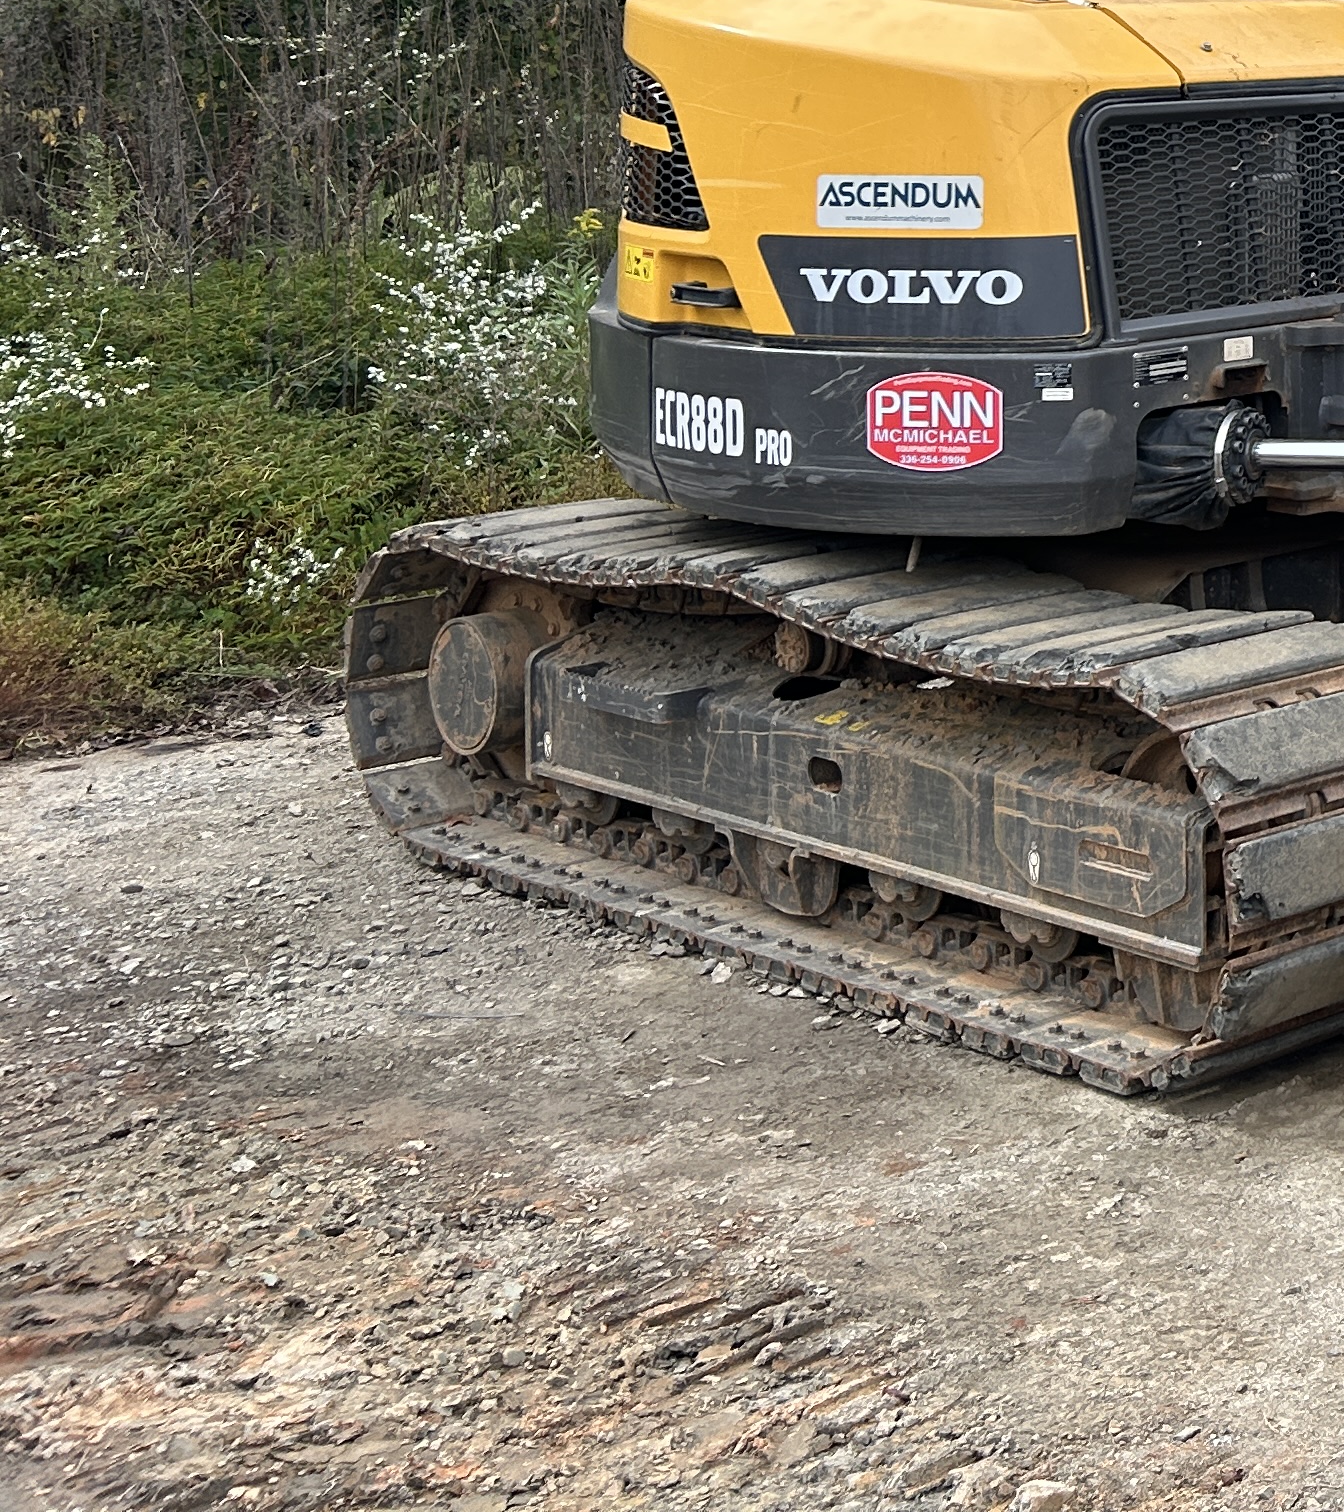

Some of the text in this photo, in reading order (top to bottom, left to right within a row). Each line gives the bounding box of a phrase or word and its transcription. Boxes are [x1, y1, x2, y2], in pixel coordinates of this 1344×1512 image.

[818, 181, 982, 209] ASCENDUM
[799, 267, 1024, 306] VOLVO
[655, 387, 793, 467] ECR88D PRO
[874, 389, 995, 429] PENN
[873, 428, 995, 444] MCMICHAEL
